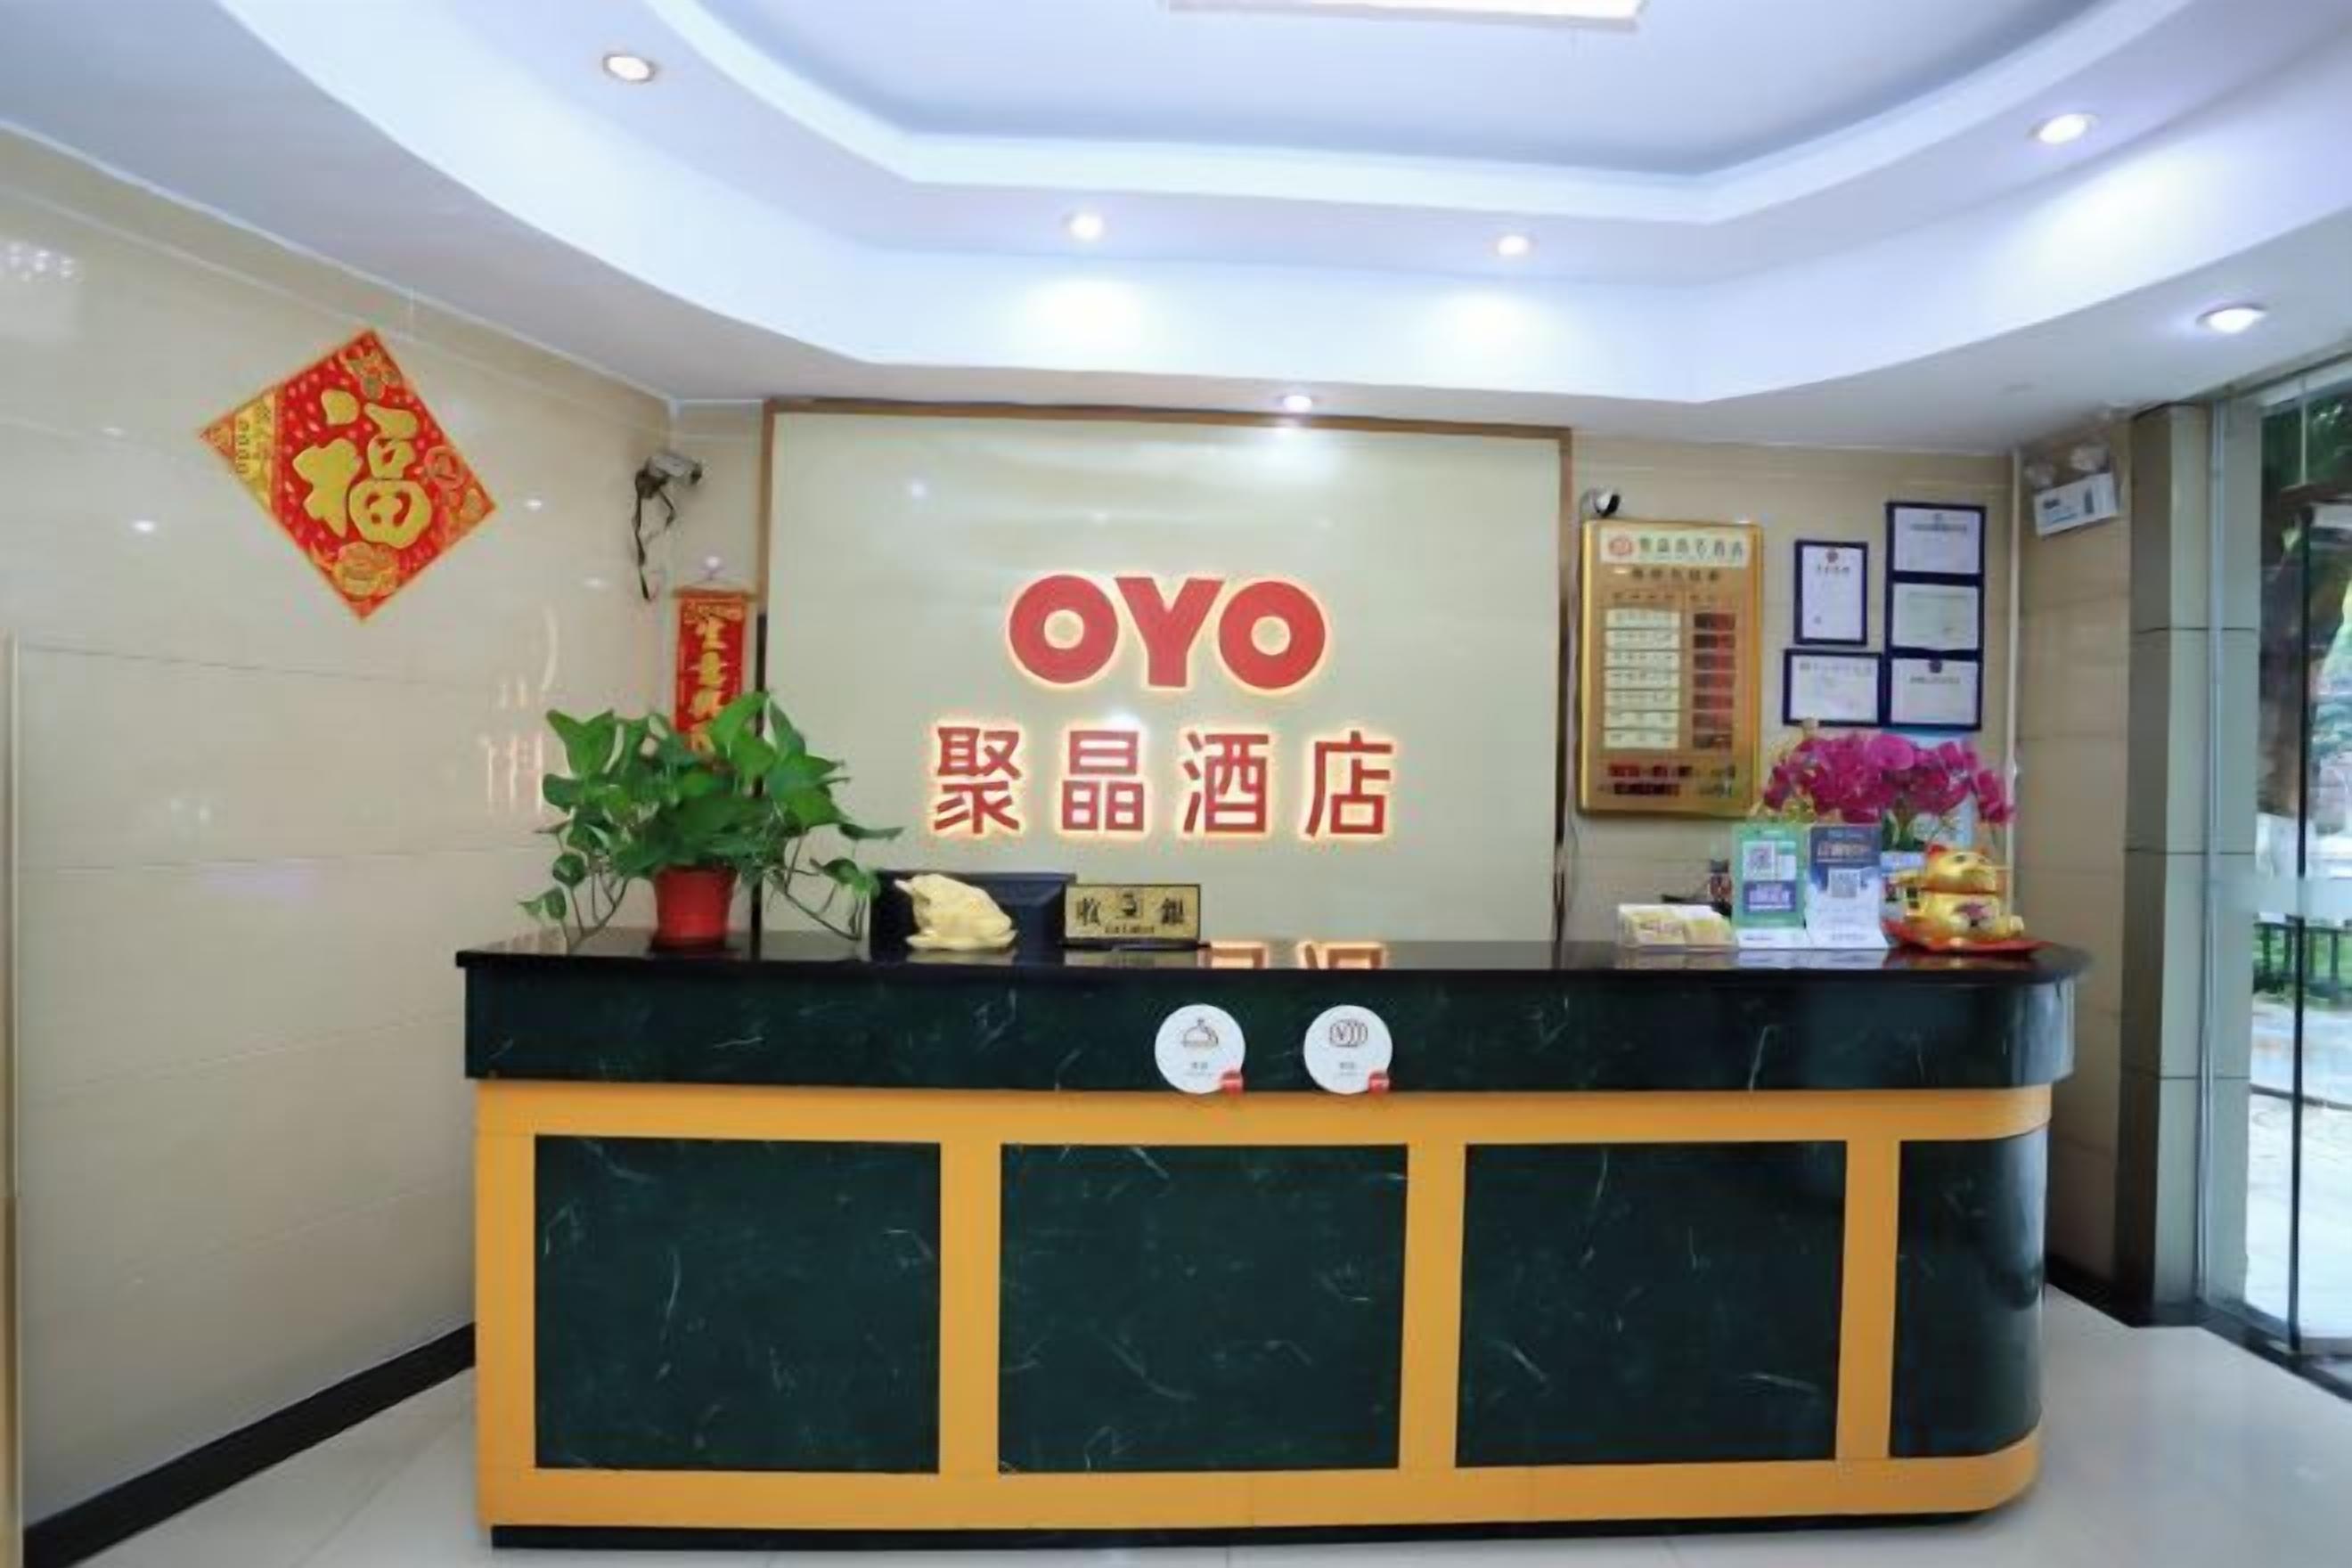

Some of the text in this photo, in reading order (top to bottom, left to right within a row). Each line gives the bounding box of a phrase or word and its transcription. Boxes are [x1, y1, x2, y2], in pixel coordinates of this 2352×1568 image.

[292, 388, 434, 550] 福
[1009, 575, 1327, 690] OYO
[934, 727, 1393, 836] 聚晶酒店
